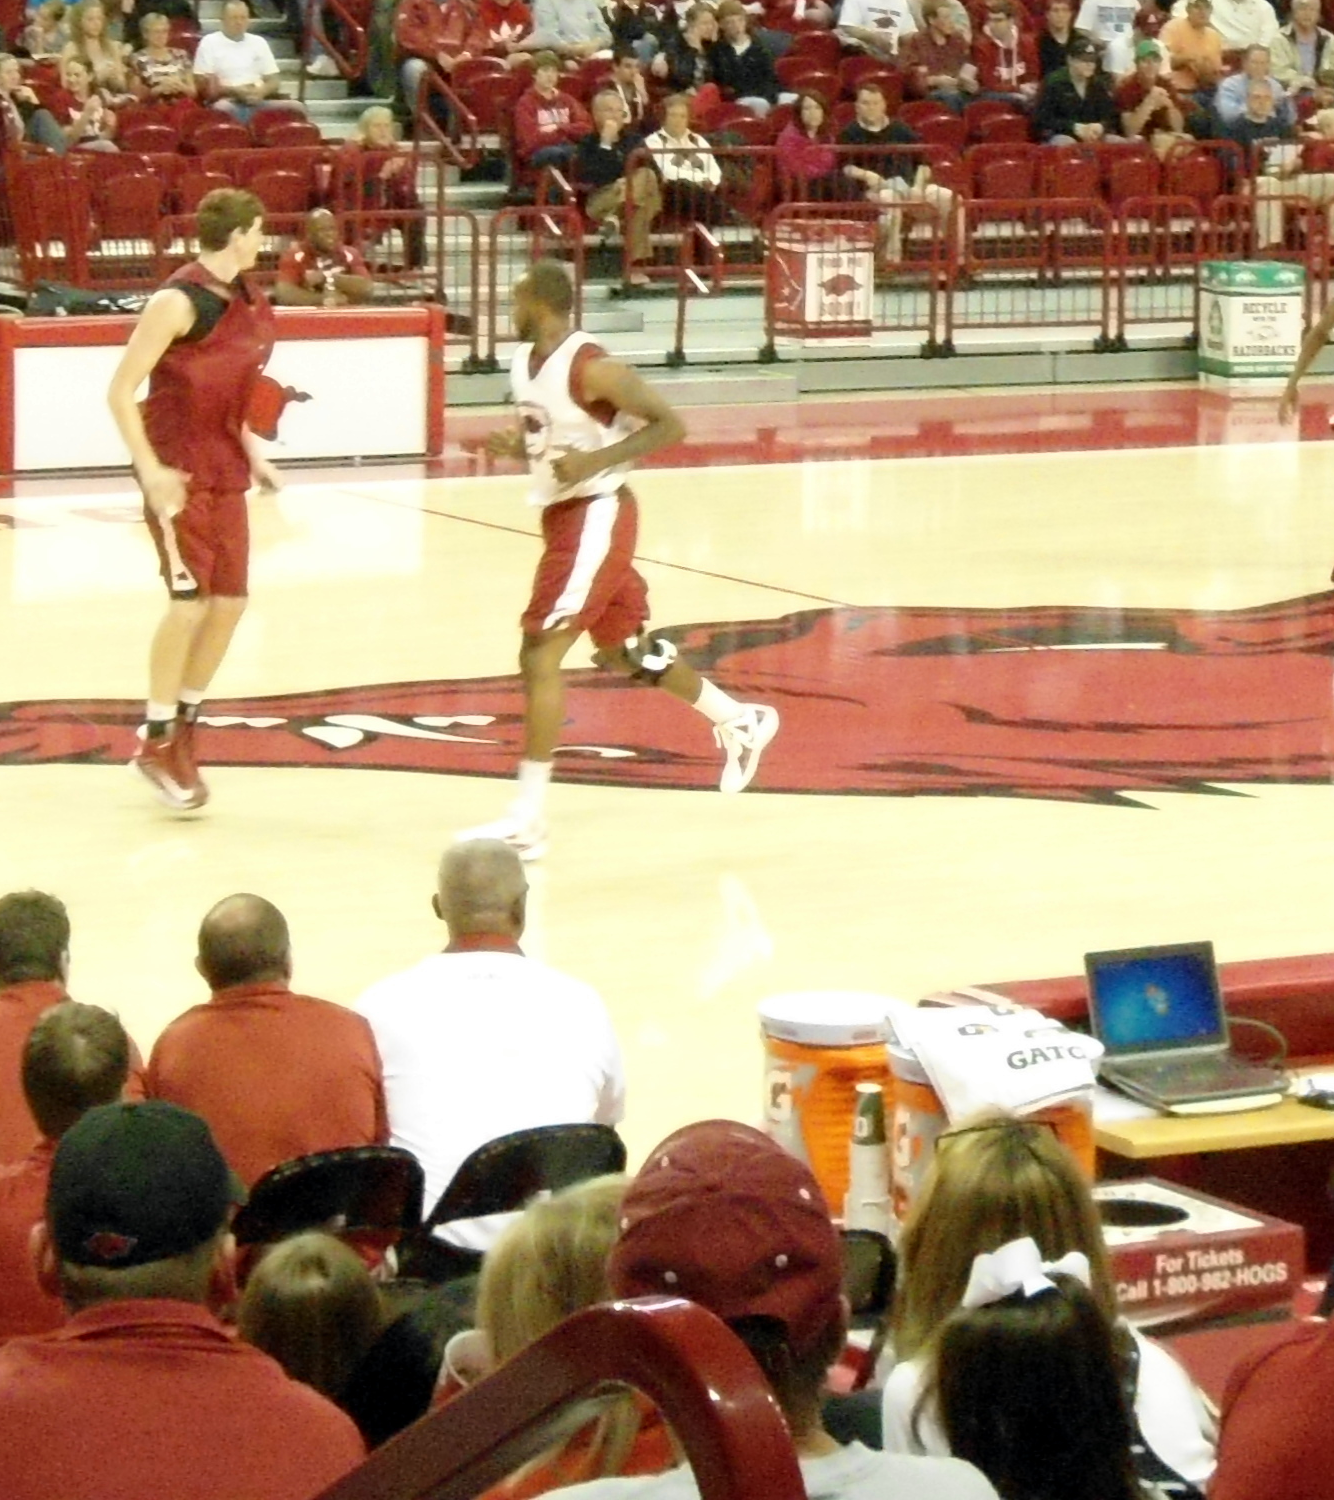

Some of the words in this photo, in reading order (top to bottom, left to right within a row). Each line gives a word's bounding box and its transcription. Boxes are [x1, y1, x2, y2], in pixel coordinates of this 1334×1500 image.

[1155, 1254, 1184, 1274] For
[1186, 1249, 1245, 1270] Tickets
[1116, 1279, 1149, 1301] Call
